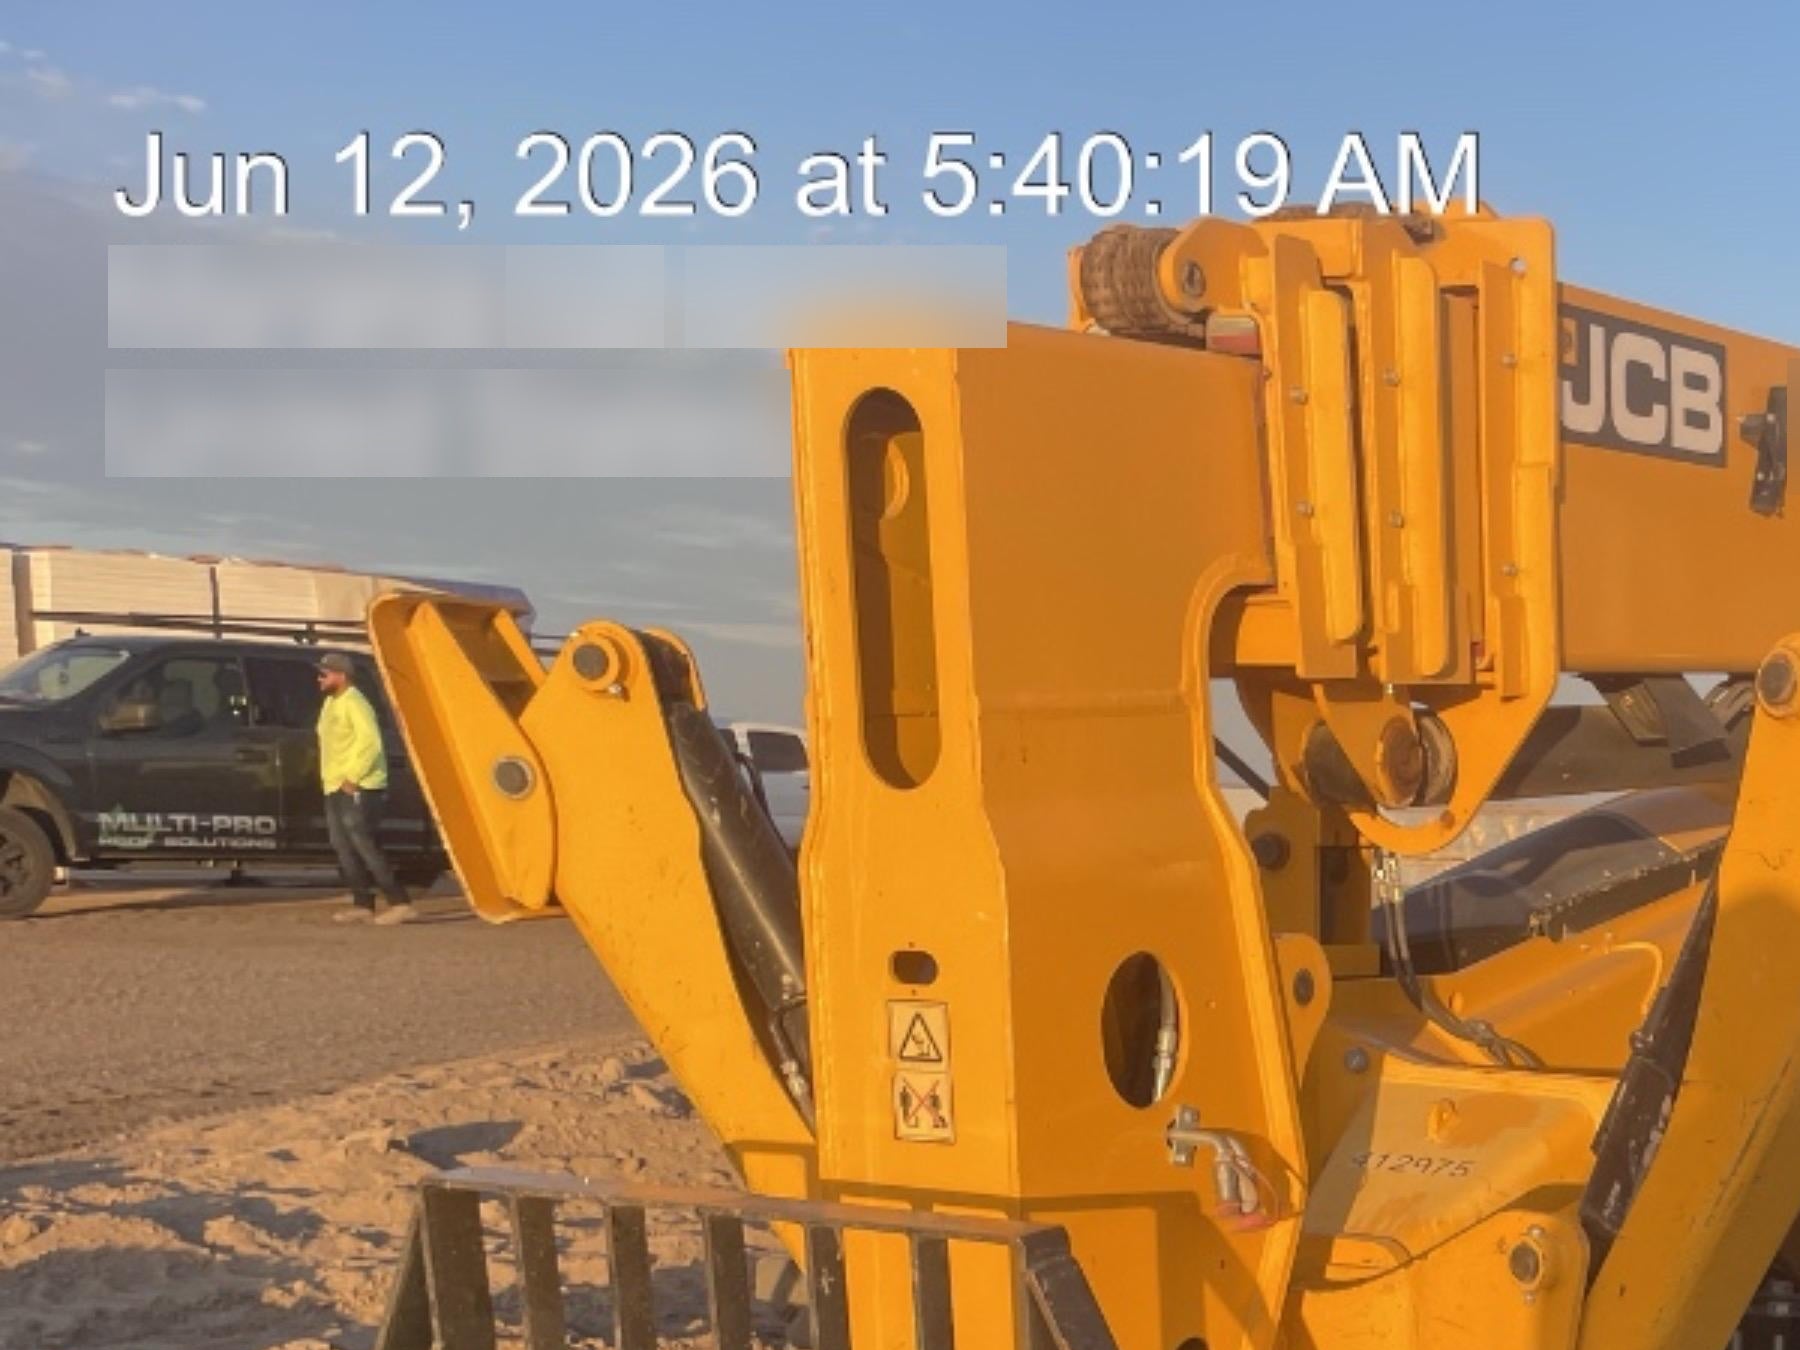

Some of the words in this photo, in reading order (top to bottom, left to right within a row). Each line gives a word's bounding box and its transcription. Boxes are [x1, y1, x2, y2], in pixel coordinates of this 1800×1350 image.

[1562, 323, 1723, 454] JCB
[97, 812, 277, 834] MULTI-PRO
[1352, 1153, 1476, 1177] 412975
